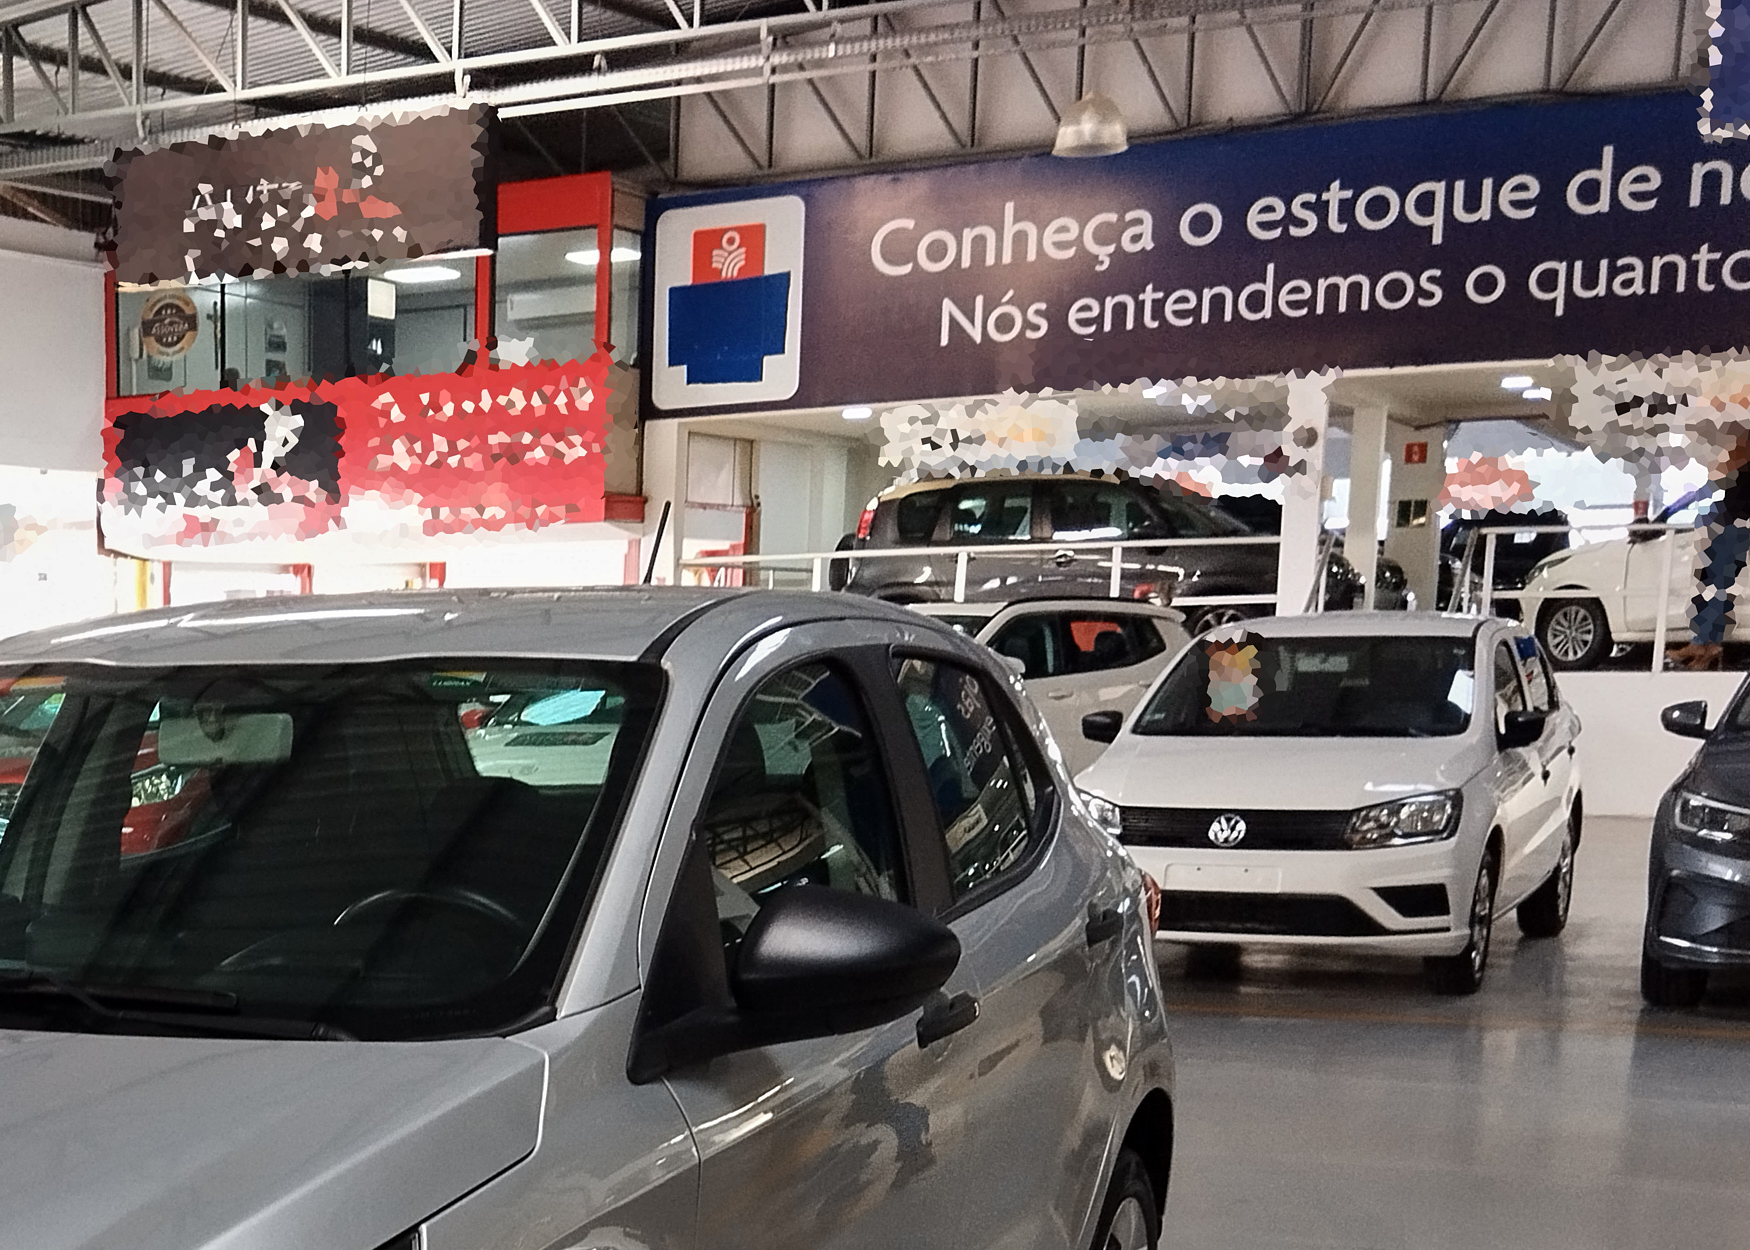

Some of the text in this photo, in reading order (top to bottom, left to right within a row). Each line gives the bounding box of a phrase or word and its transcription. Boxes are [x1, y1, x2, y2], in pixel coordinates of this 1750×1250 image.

[870, 145, 1750, 276] Conheça o estoque de n
[939, 242, 1750, 347] Nós entendemos o quanto
